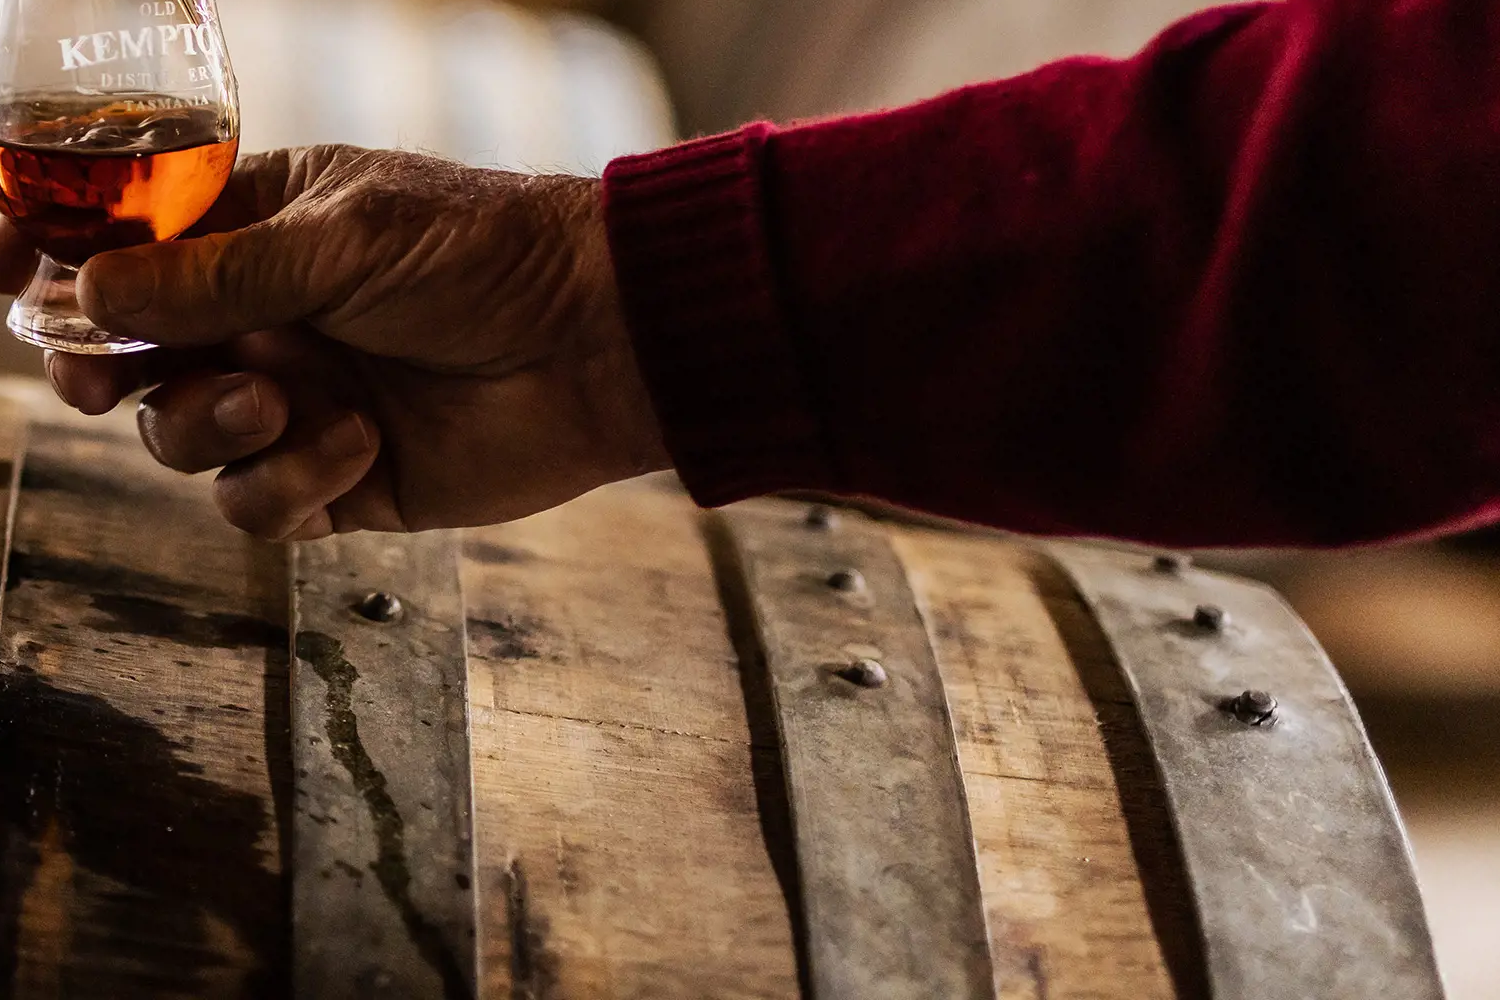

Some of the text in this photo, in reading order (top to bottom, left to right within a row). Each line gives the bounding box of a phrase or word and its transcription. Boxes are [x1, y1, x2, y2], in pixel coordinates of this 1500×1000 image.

[139, 1, 176, 17] OLD
[58, 23, 221, 71] KEMPTO
[101, 65, 214, 88] DISTERY
[124, 95, 209, 112] TASMANIA
